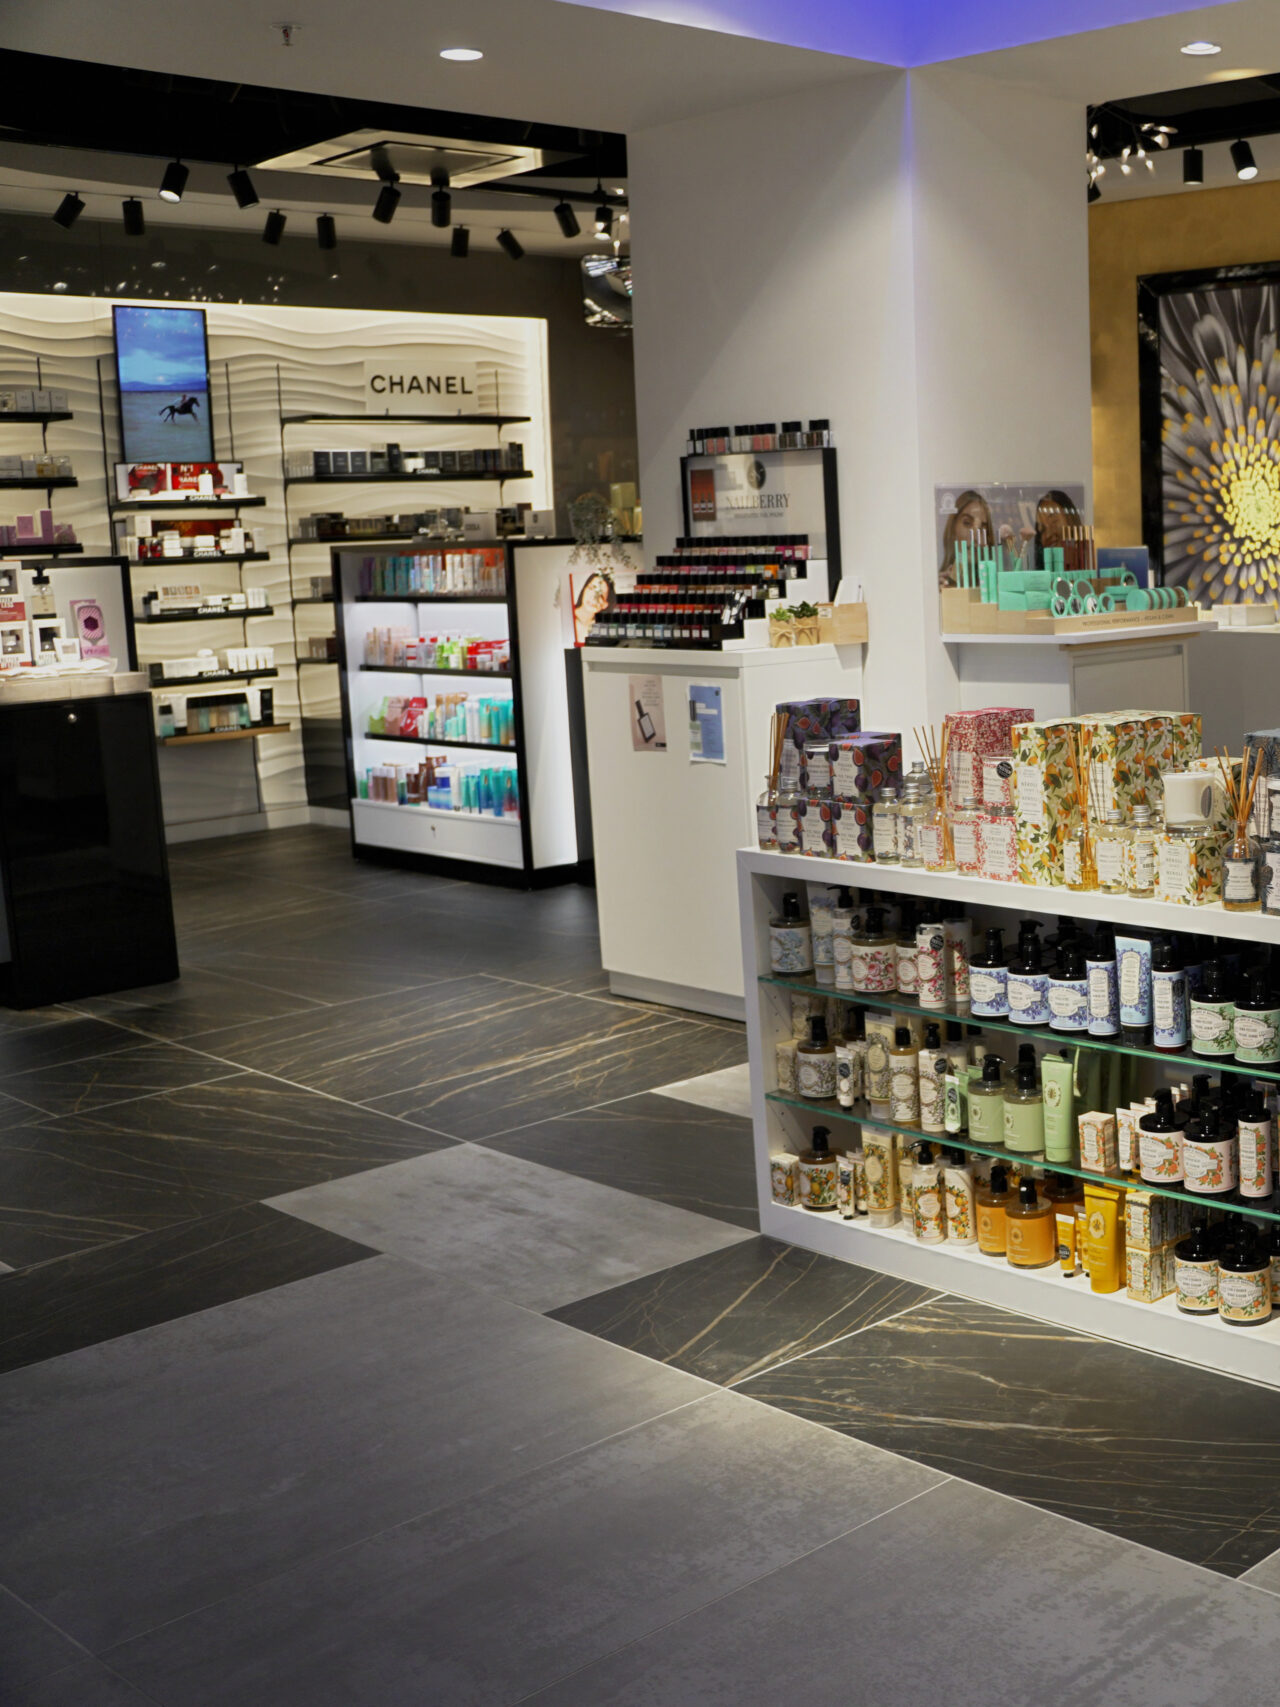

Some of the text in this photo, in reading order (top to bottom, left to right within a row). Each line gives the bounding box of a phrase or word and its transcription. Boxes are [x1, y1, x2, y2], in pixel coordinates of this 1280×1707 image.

[370, 374, 474, 395] CHANEL
[725, 493, 792, 511] NAILBERRY
[194, 550, 222, 558] CHANEL
[197, 606, 226, 614] CHANEL
[203, 669, 231, 678] CHANEL
